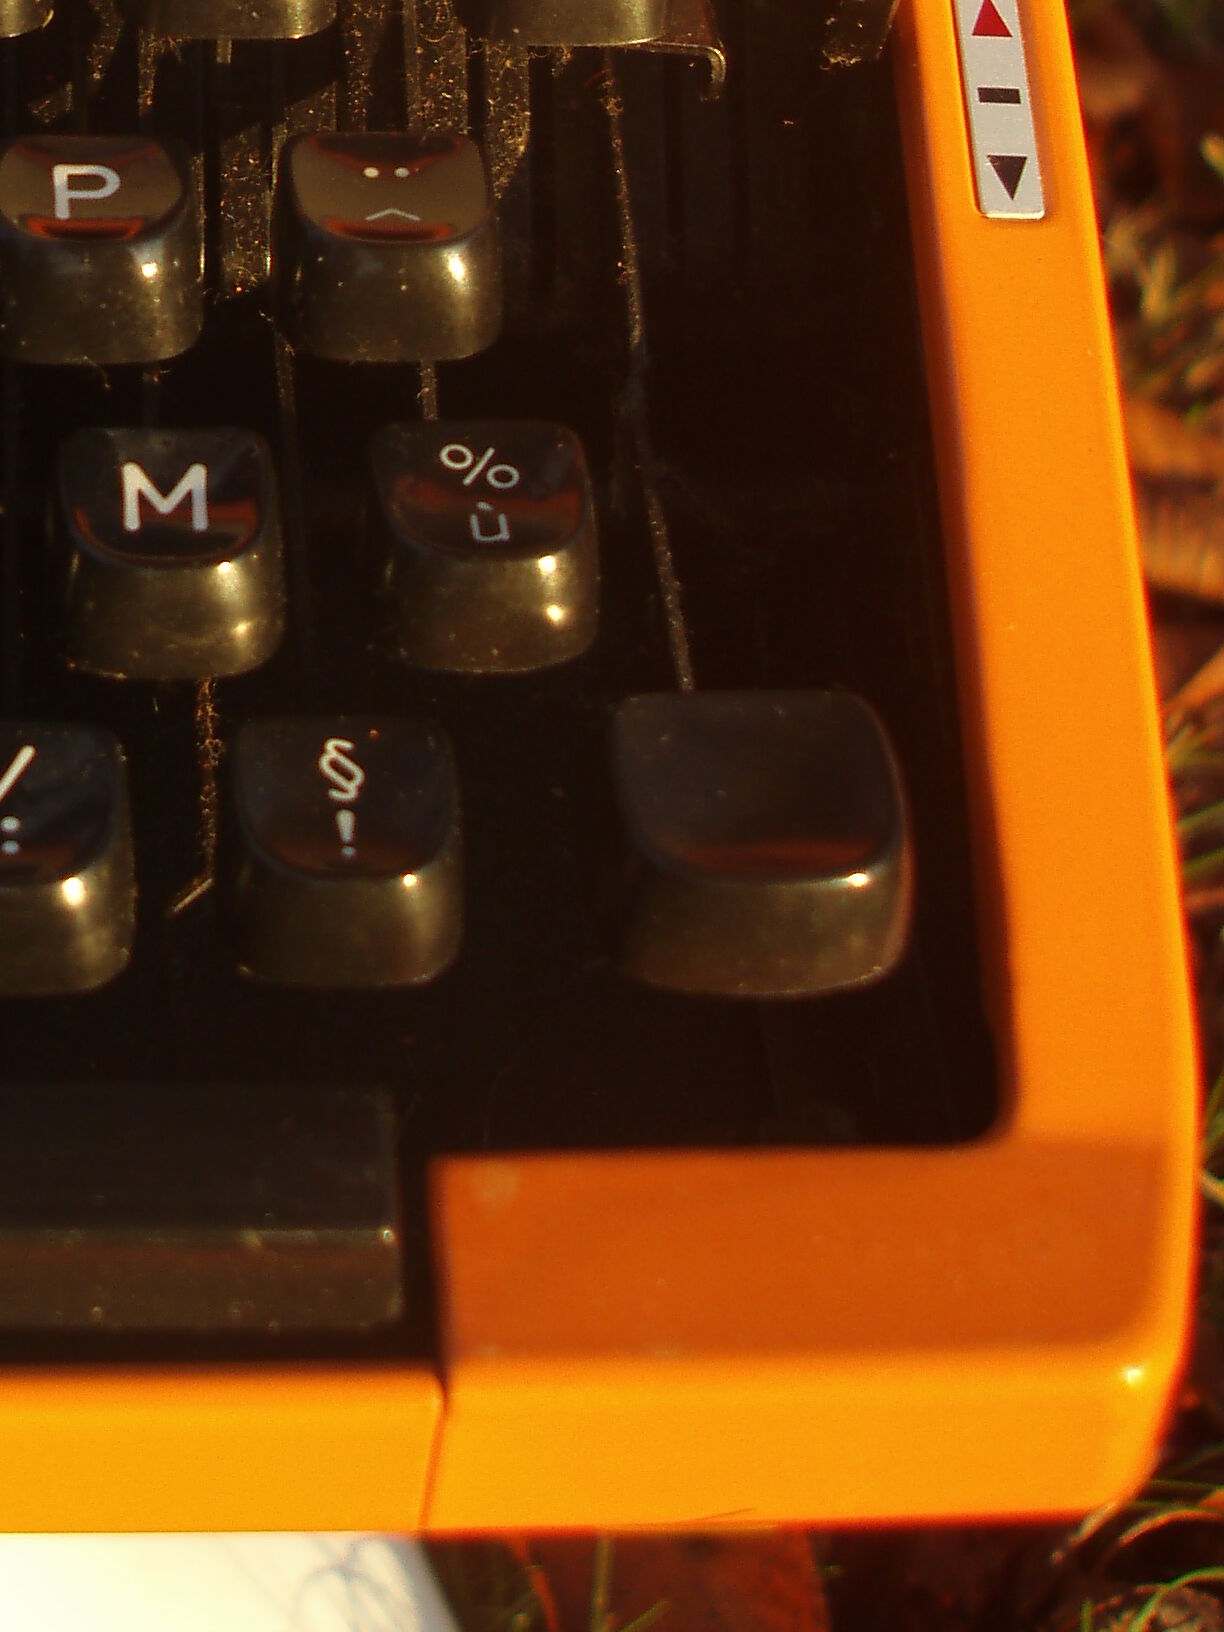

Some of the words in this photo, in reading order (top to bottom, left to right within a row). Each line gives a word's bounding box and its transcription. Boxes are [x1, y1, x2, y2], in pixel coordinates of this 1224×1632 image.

[52, 164, 121, 220] P
[440, 444, 520, 489] %
[122, 463, 208, 531] M
[470, 501, 511, 542] ù
[320, 739, 364, 802] §
[336, 808, 356, 858] !
